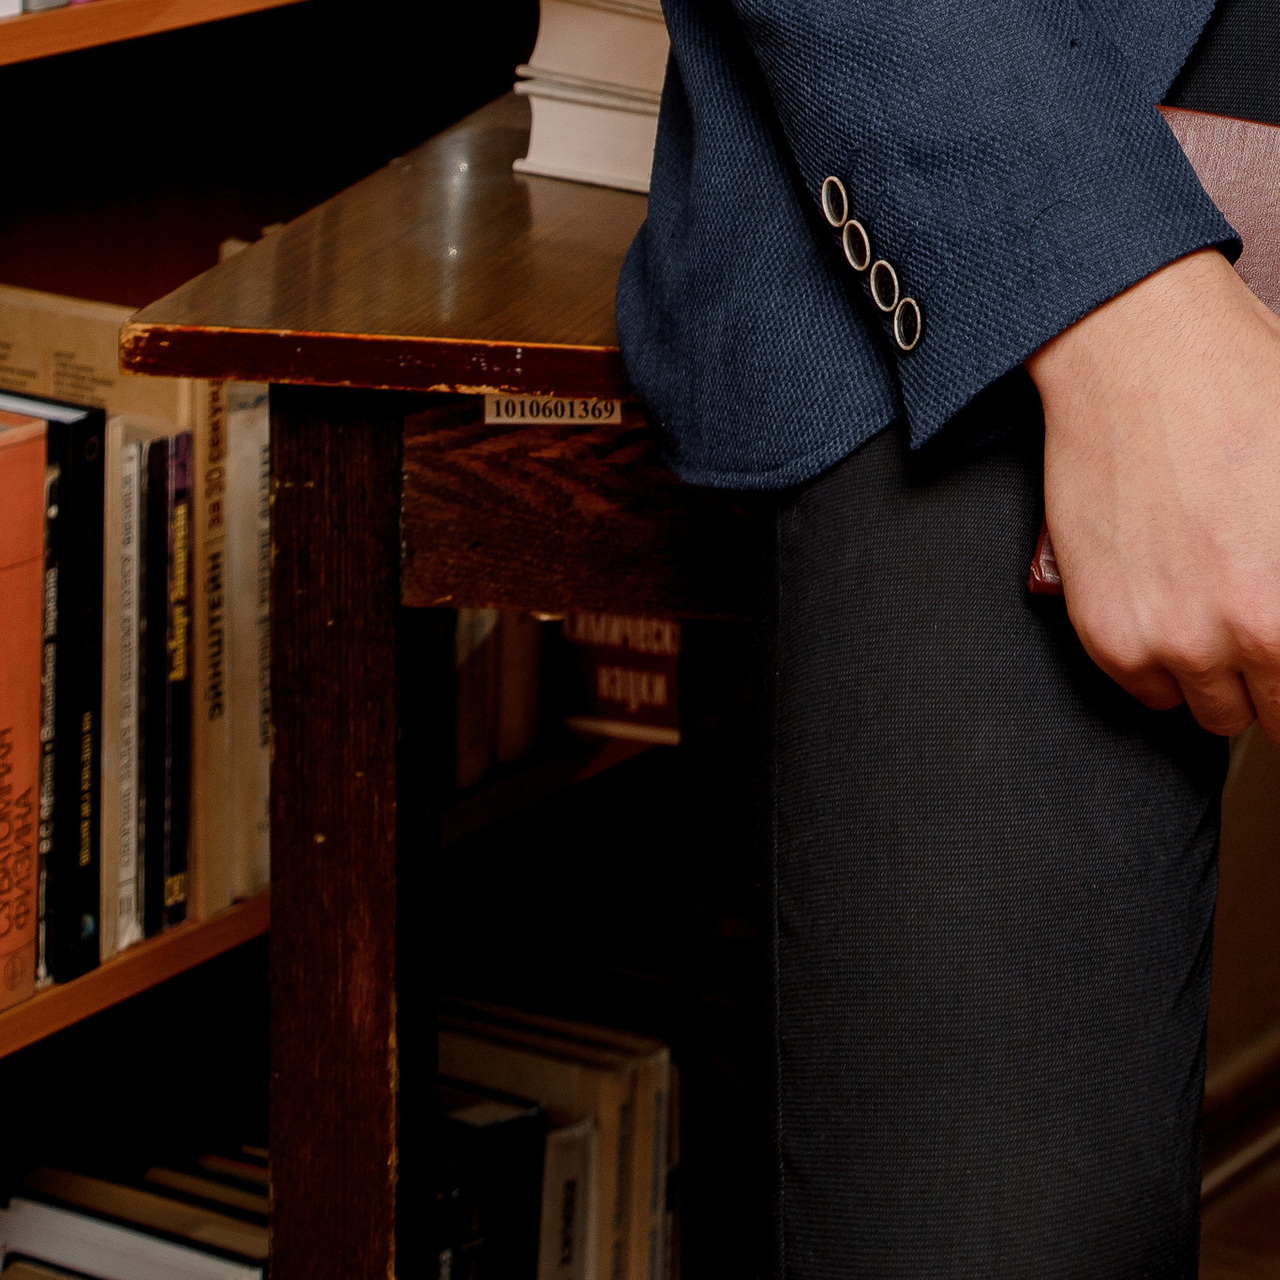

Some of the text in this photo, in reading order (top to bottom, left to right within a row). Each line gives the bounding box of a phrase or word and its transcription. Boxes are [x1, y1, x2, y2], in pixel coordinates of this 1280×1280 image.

[494, 398, 615, 419] 1010601369
[204, 467, 223, 499] 30
[207, 500, 222, 531] за
[203, 551, 225, 723] ЭЙНШТЕЙН
[597, 665, 667, 713] науки
[11, 786, 34, 931] ФИЗИКА
